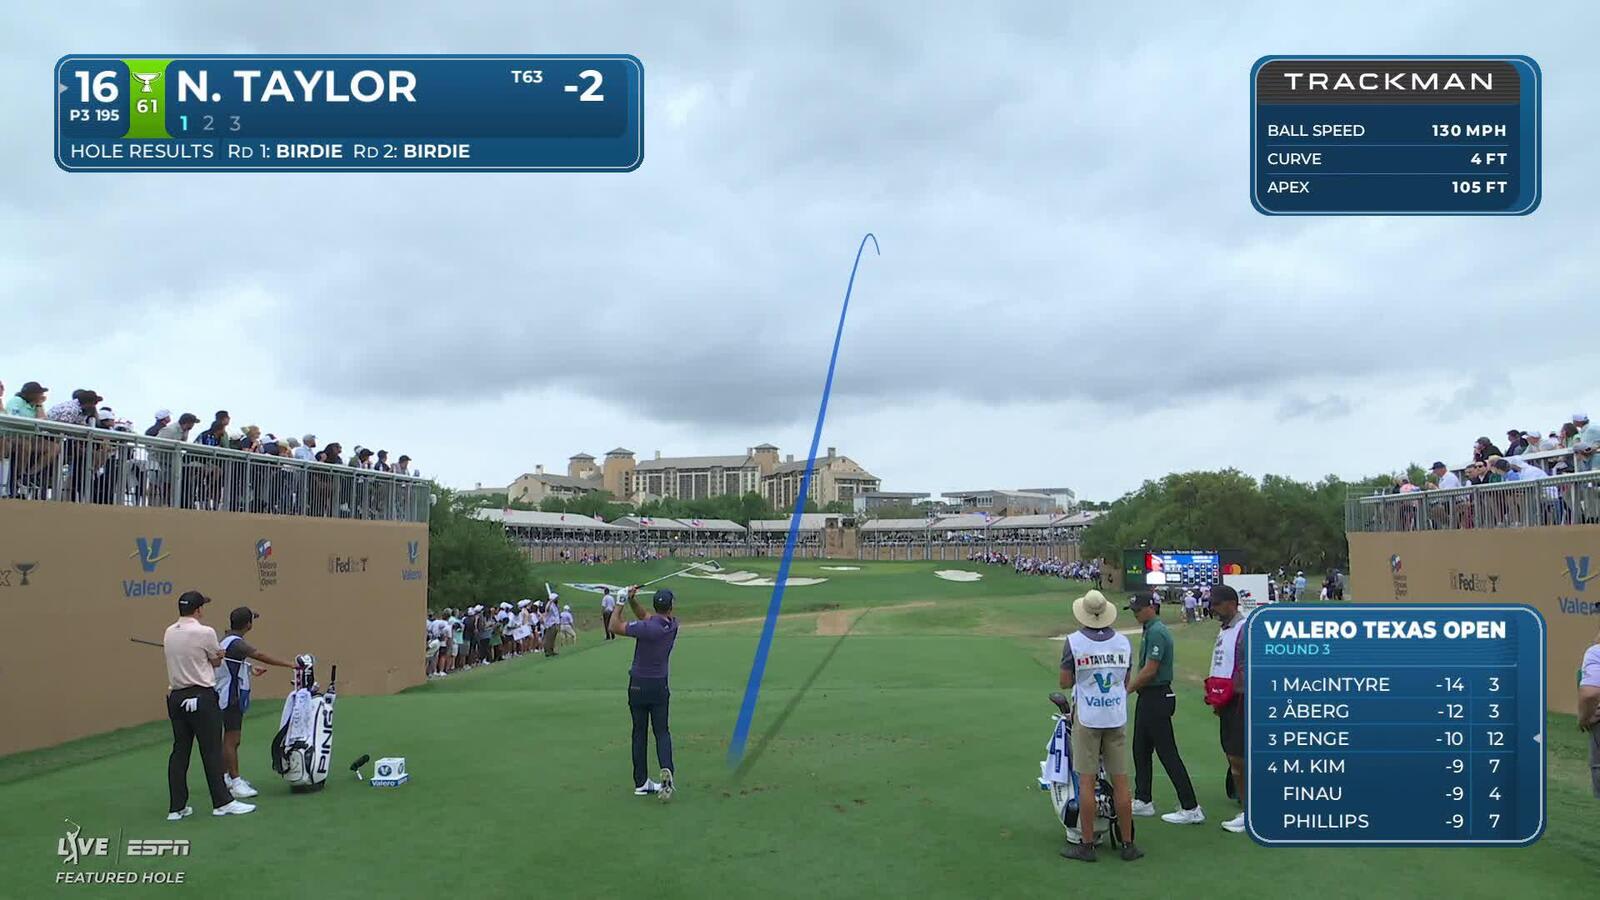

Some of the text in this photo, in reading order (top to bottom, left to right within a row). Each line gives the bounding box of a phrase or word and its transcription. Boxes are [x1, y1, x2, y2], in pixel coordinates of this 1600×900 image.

[122, 580, 173, 597] Valero
[1557, 596, 1600, 616] Valer
[1085, 696, 1121, 708] Valero
